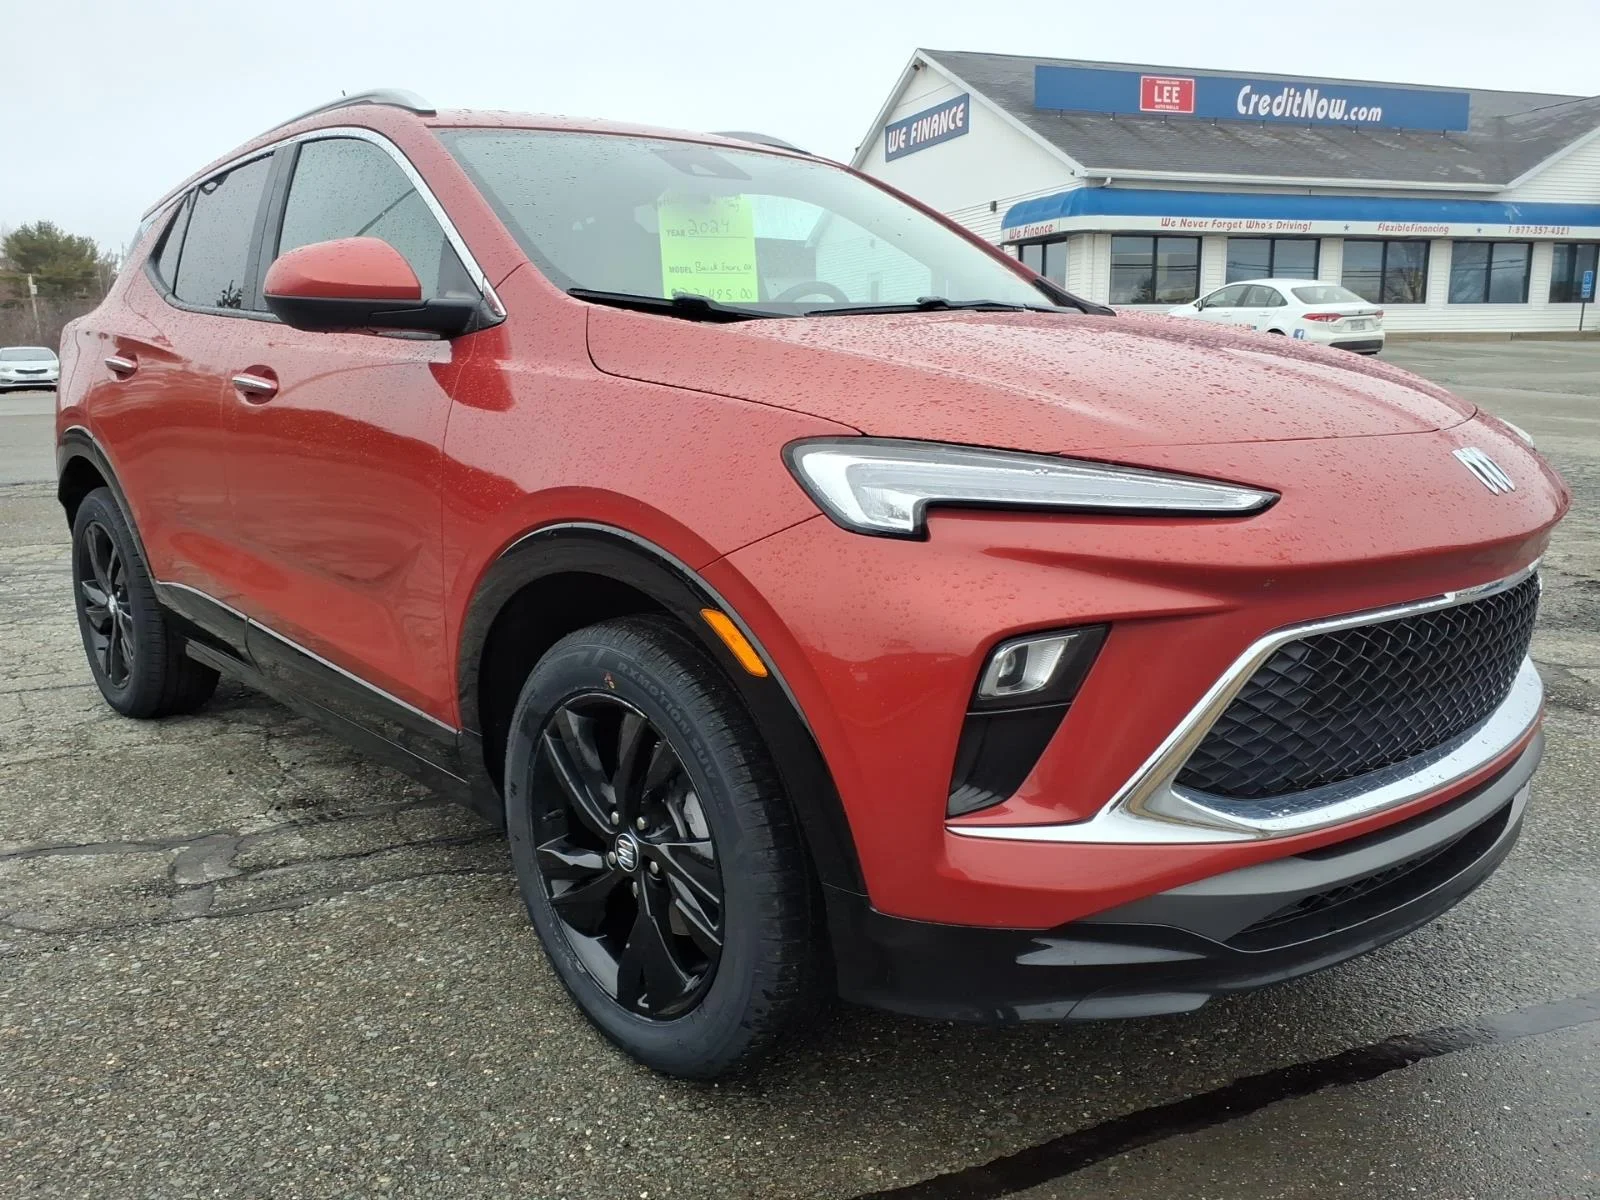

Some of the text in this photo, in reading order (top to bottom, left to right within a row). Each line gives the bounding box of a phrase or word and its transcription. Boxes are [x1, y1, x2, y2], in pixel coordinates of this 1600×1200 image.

[1154, 85, 1181, 104] LEE
[1236, 84, 1383, 122] CreditNow.com
[888, 102, 965, 154] WE FINANCE
[666, 218, 730, 237] YEAR 2024
[1009, 223, 1054, 239] We Finance
[1160, 217, 1312, 232] We Never Forget Who's Driving!
[668, 265, 693, 274] MODEL
